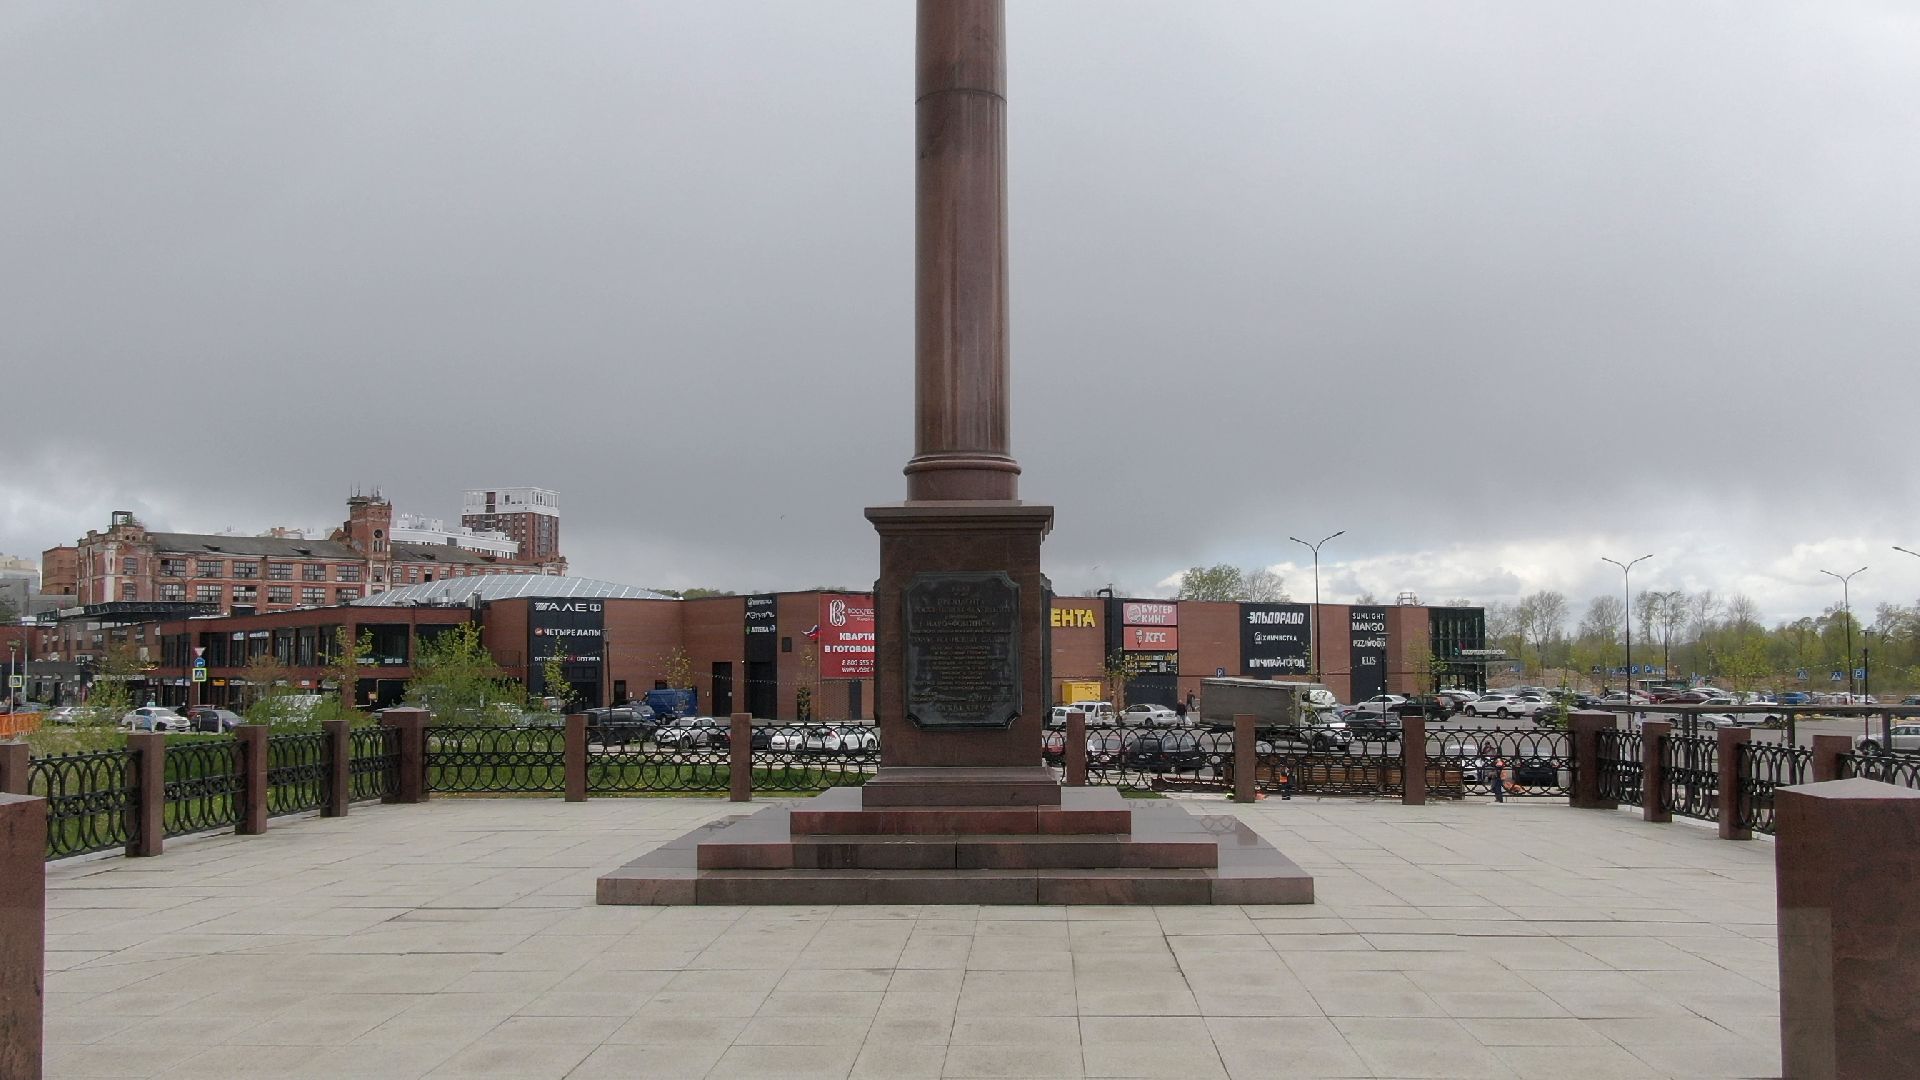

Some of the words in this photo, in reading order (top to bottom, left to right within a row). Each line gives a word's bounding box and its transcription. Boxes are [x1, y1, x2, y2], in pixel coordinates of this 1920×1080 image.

[1141, 604, 1173, 614] БУРГЕР
[1051, 607, 1096, 628] ЕНТА
[1141, 614, 1166, 624] КИНГ
[1247, 611, 1304, 625] ЭЛЬДОРАДО
[1352, 612, 1385, 620] SUNLIGHT
[1352, 622, 1385, 632] MANGO
[544, 628, 576, 636] ЧЕТЫРЕ
[576, 629, 601, 637] ЛАПЫ
[1144, 632, 1167, 643] KFC
